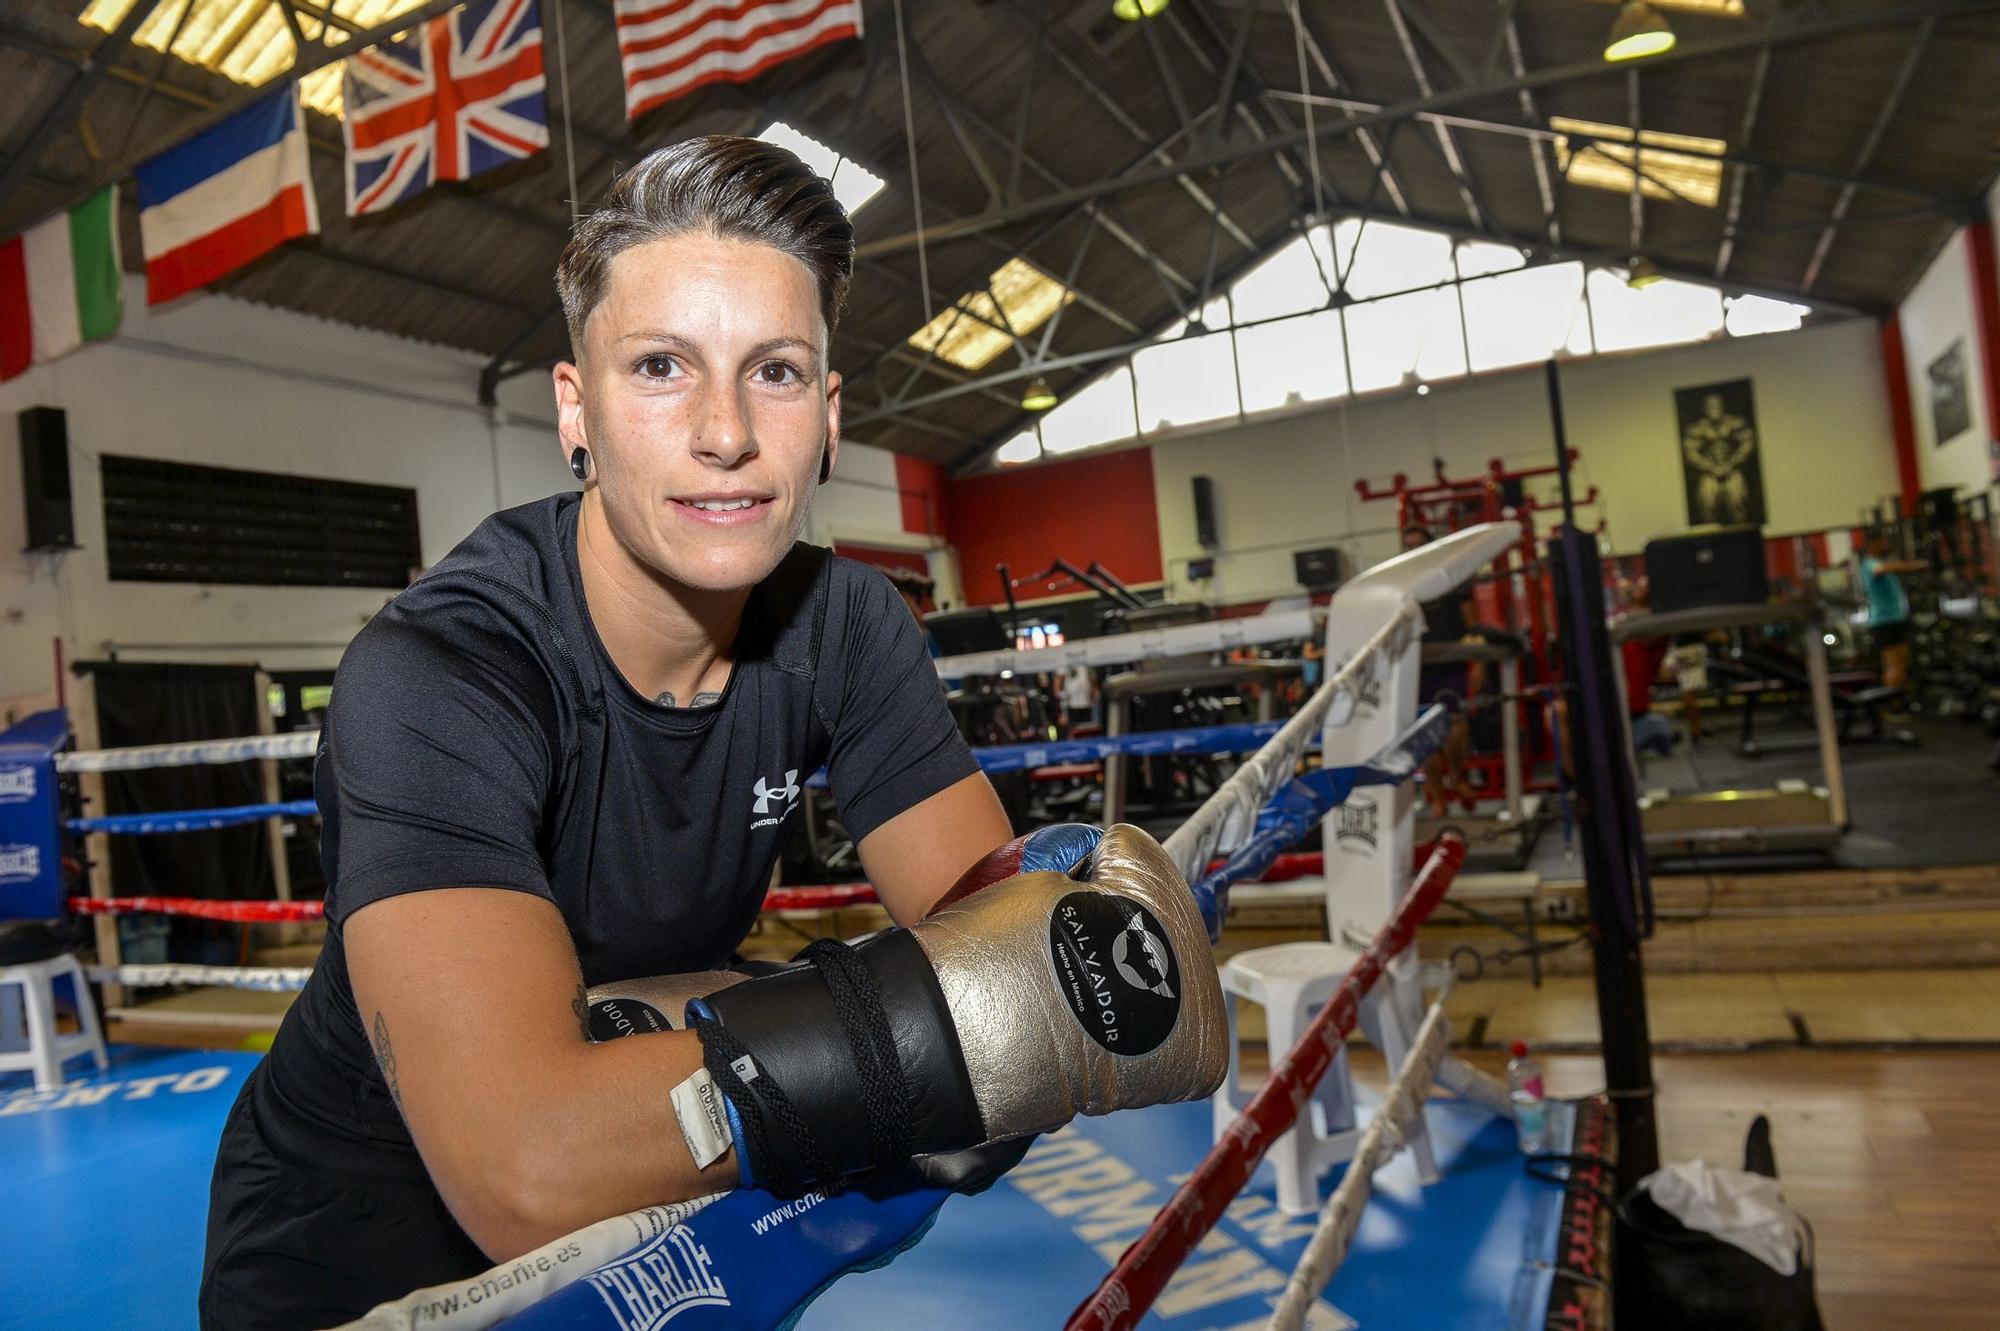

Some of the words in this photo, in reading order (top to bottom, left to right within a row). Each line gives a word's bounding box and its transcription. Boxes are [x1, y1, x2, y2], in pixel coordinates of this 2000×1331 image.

[750, 818, 779, 830] UNDER
[1056, 943, 1071, 969] Hecho
[1067, 969, 1075, 981] en
[1071, 981, 1085, 1012] Mexico
[1061, 905, 1119, 1043] SALVADOR
[586, 1223, 728, 1331] CHARLIE
